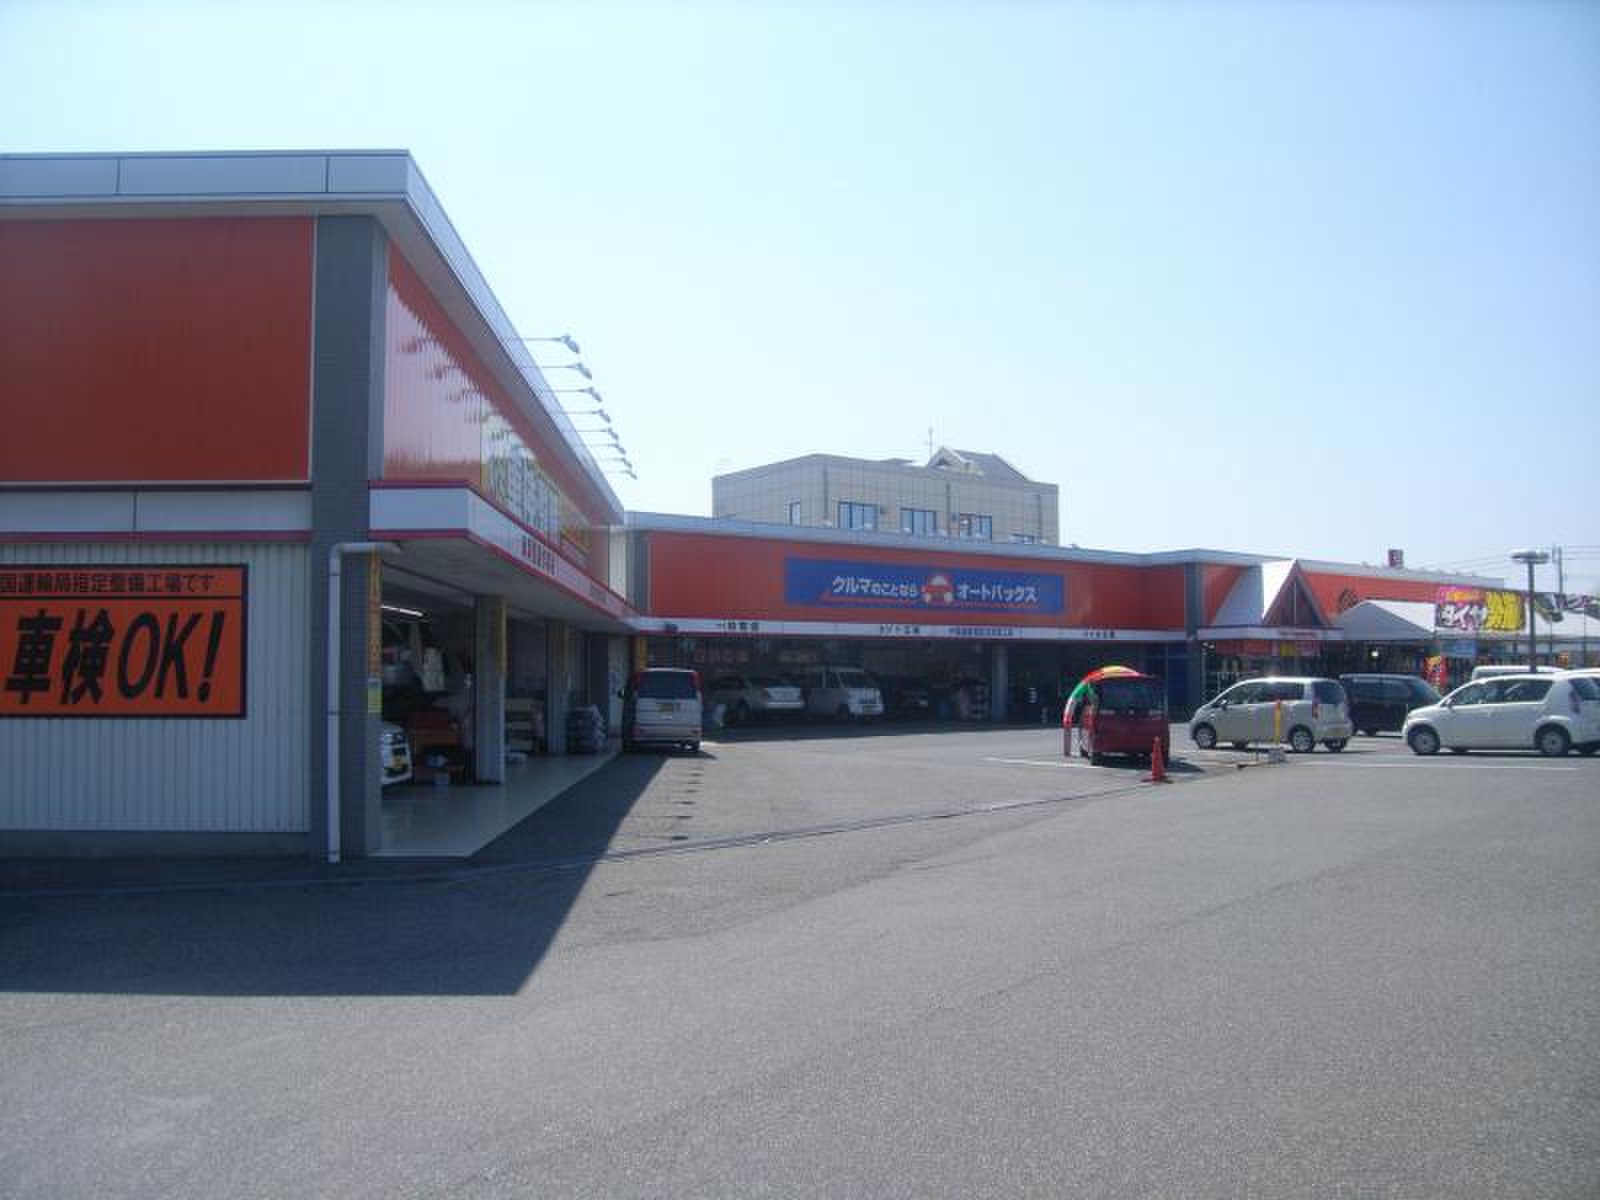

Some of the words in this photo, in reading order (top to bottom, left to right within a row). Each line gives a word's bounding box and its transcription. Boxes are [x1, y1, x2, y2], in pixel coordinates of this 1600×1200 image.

[832, 576, 917, 598] クルマのことなら
[5, 608, 225, 705] 車検OK!
